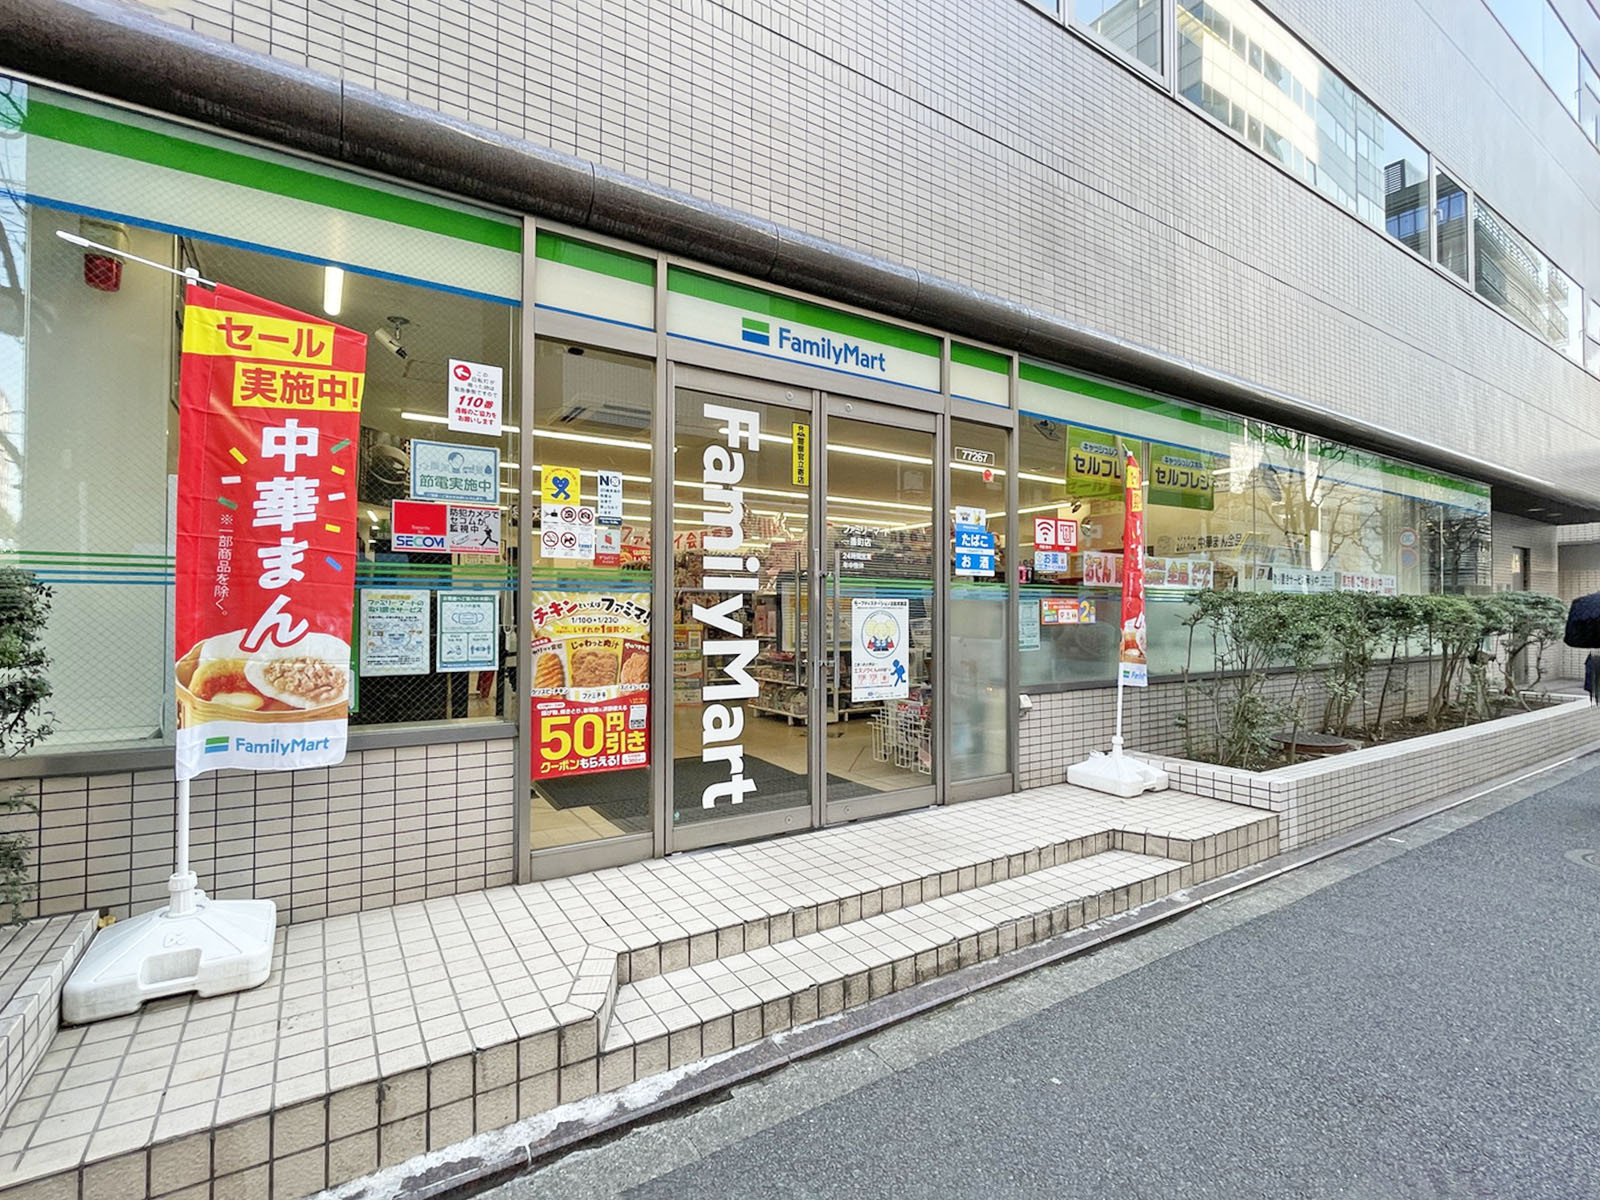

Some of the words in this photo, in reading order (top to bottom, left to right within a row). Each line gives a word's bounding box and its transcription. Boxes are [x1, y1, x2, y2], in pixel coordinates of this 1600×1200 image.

[217, 317, 325, 358] セール
[778, 327, 886, 372] FamilyMart
[240, 368, 361, 408] 実施中!
[459, 395, 494, 409] 110番
[458, 415, 494, 425] お願いします
[419, 474, 492, 493] 節電実施中
[450, 508, 499, 520] 防犯カメラで
[252, 418, 320, 650] 中華まん
[450, 524, 479, 534] 監視中
[396, 536, 445, 548] SECOM
[961, 533, 989, 548] たばこ
[215, 514, 234, 616] ※一部商品を除く。
[692, 403, 761, 810] FamilyMart
[540, 711, 646, 761] 50円引き
[235, 737, 329, 756] FamilyMart
[540, 754, 621, 774] クーポンもらえる!
